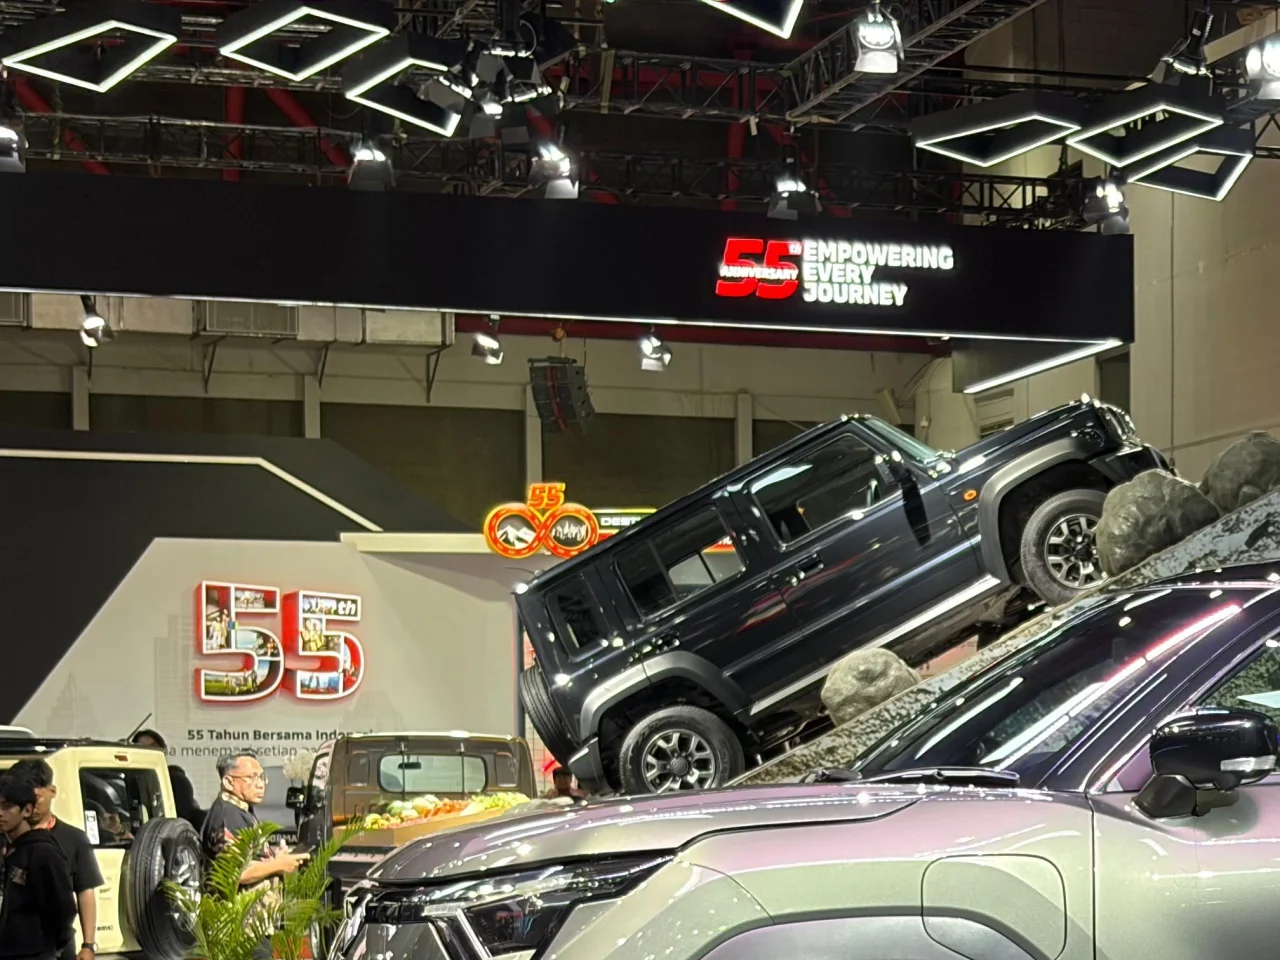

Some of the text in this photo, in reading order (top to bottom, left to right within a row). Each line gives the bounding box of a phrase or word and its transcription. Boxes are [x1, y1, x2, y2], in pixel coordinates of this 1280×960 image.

[802, 240, 954, 270] EMPOWERING
[719, 265, 799, 280] ANNIVERSARY
[803, 262, 875, 284] EVERY
[803, 281, 908, 306] JOURNEY
[527, 483, 565, 509] 55
[187, 729, 204, 741] 55
[208, 729, 251, 741] Tahun
[253, 729, 312, 741] Bersama
